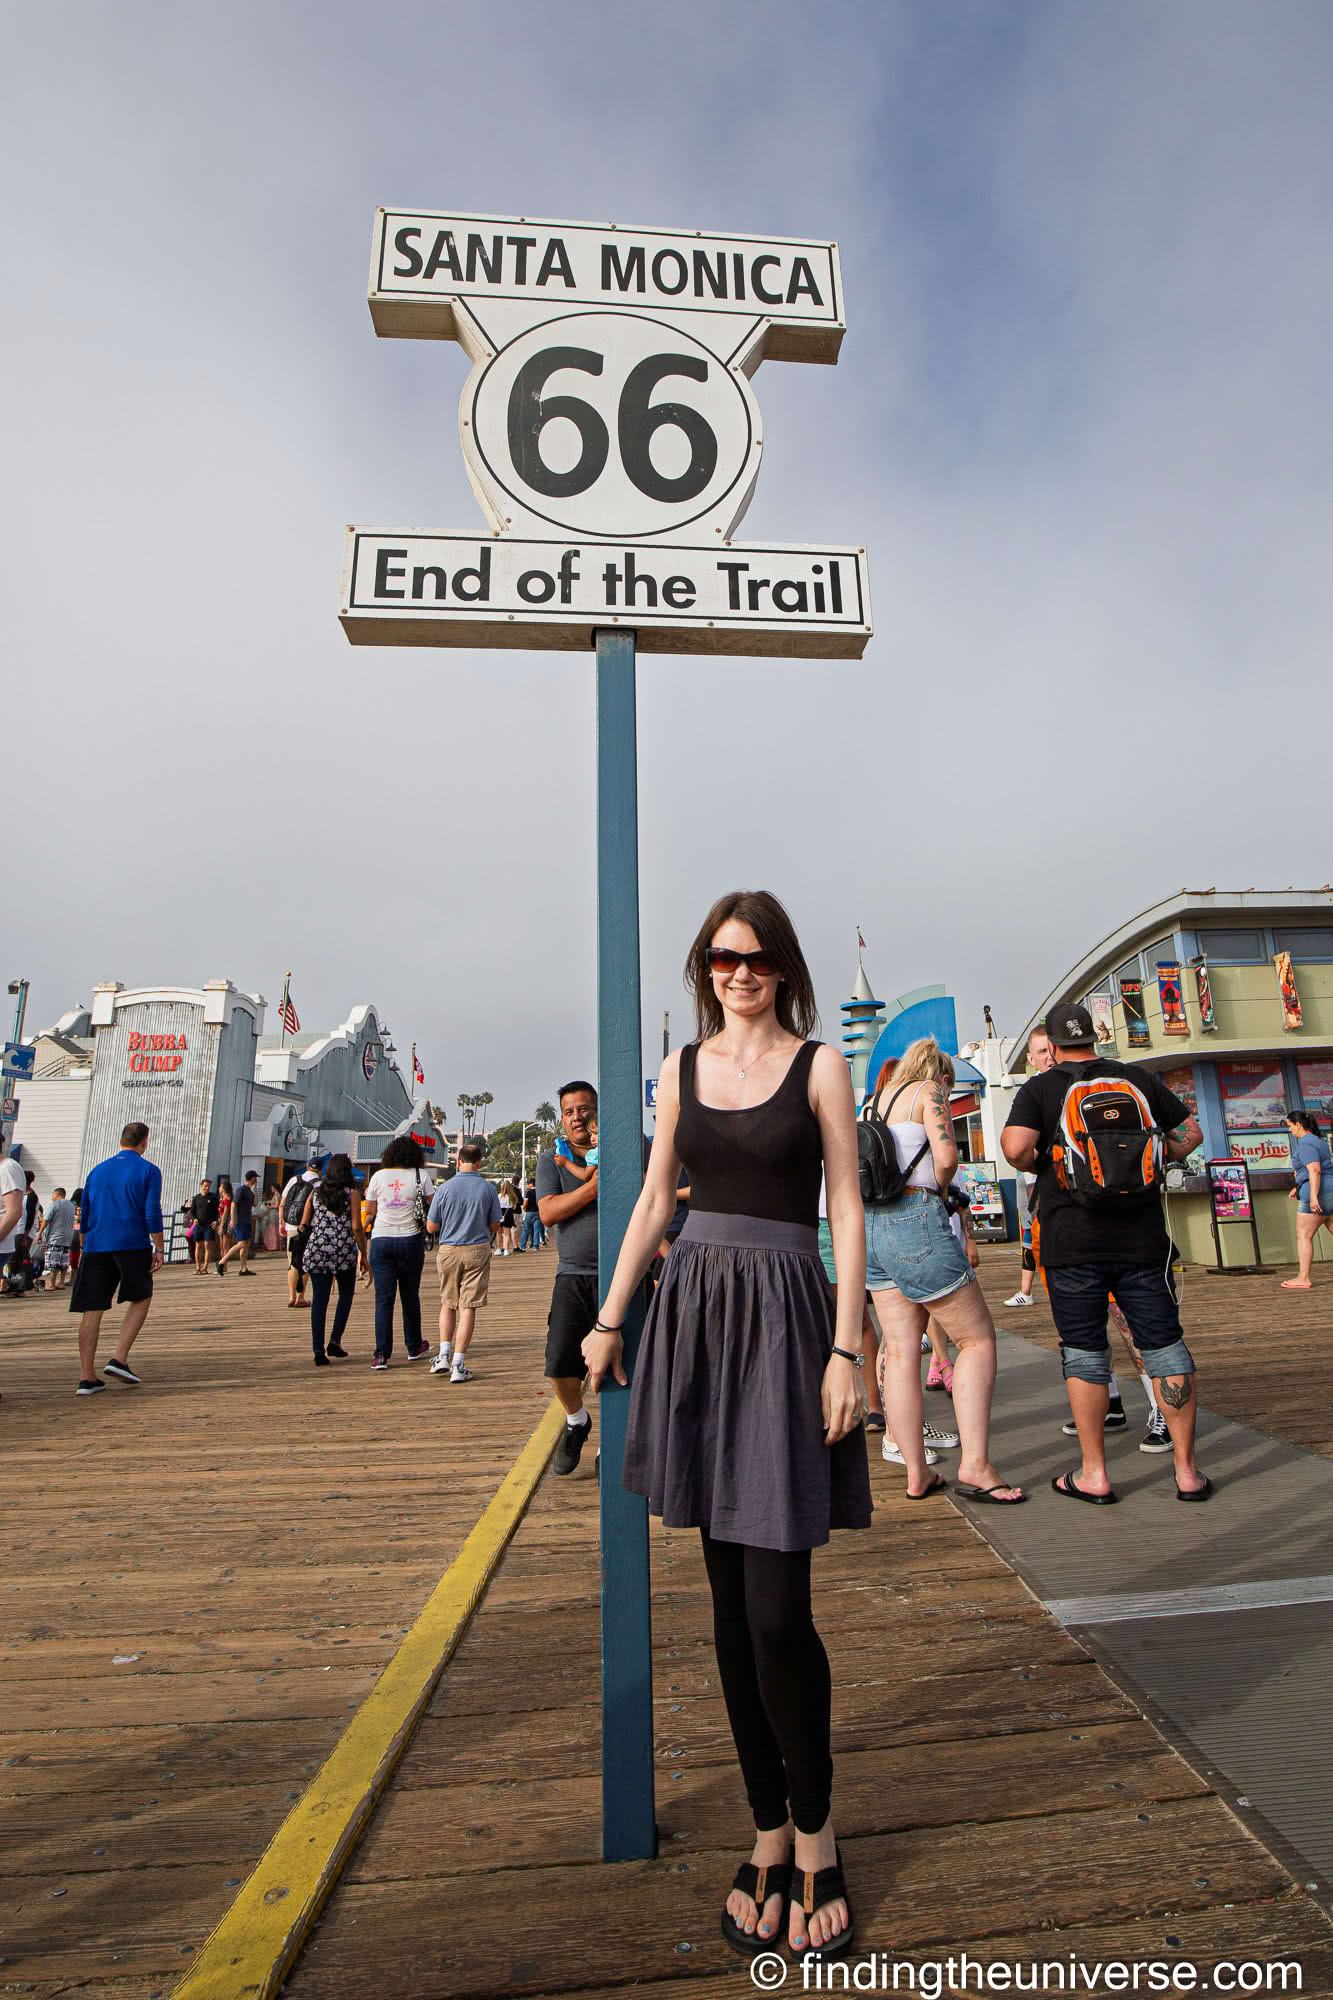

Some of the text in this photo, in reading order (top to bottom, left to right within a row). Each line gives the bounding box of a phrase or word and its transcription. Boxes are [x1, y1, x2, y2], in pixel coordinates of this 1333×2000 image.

[392, 226, 826, 307] SANTA MONICA
[507, 345, 719, 505] 66
[373, 546, 844, 615] End of the Trail
[1121, 983, 1141, 992] UFO
[127, 1031, 188, 1052] BUBBA
[129, 1053, 183, 1073] GUMP
